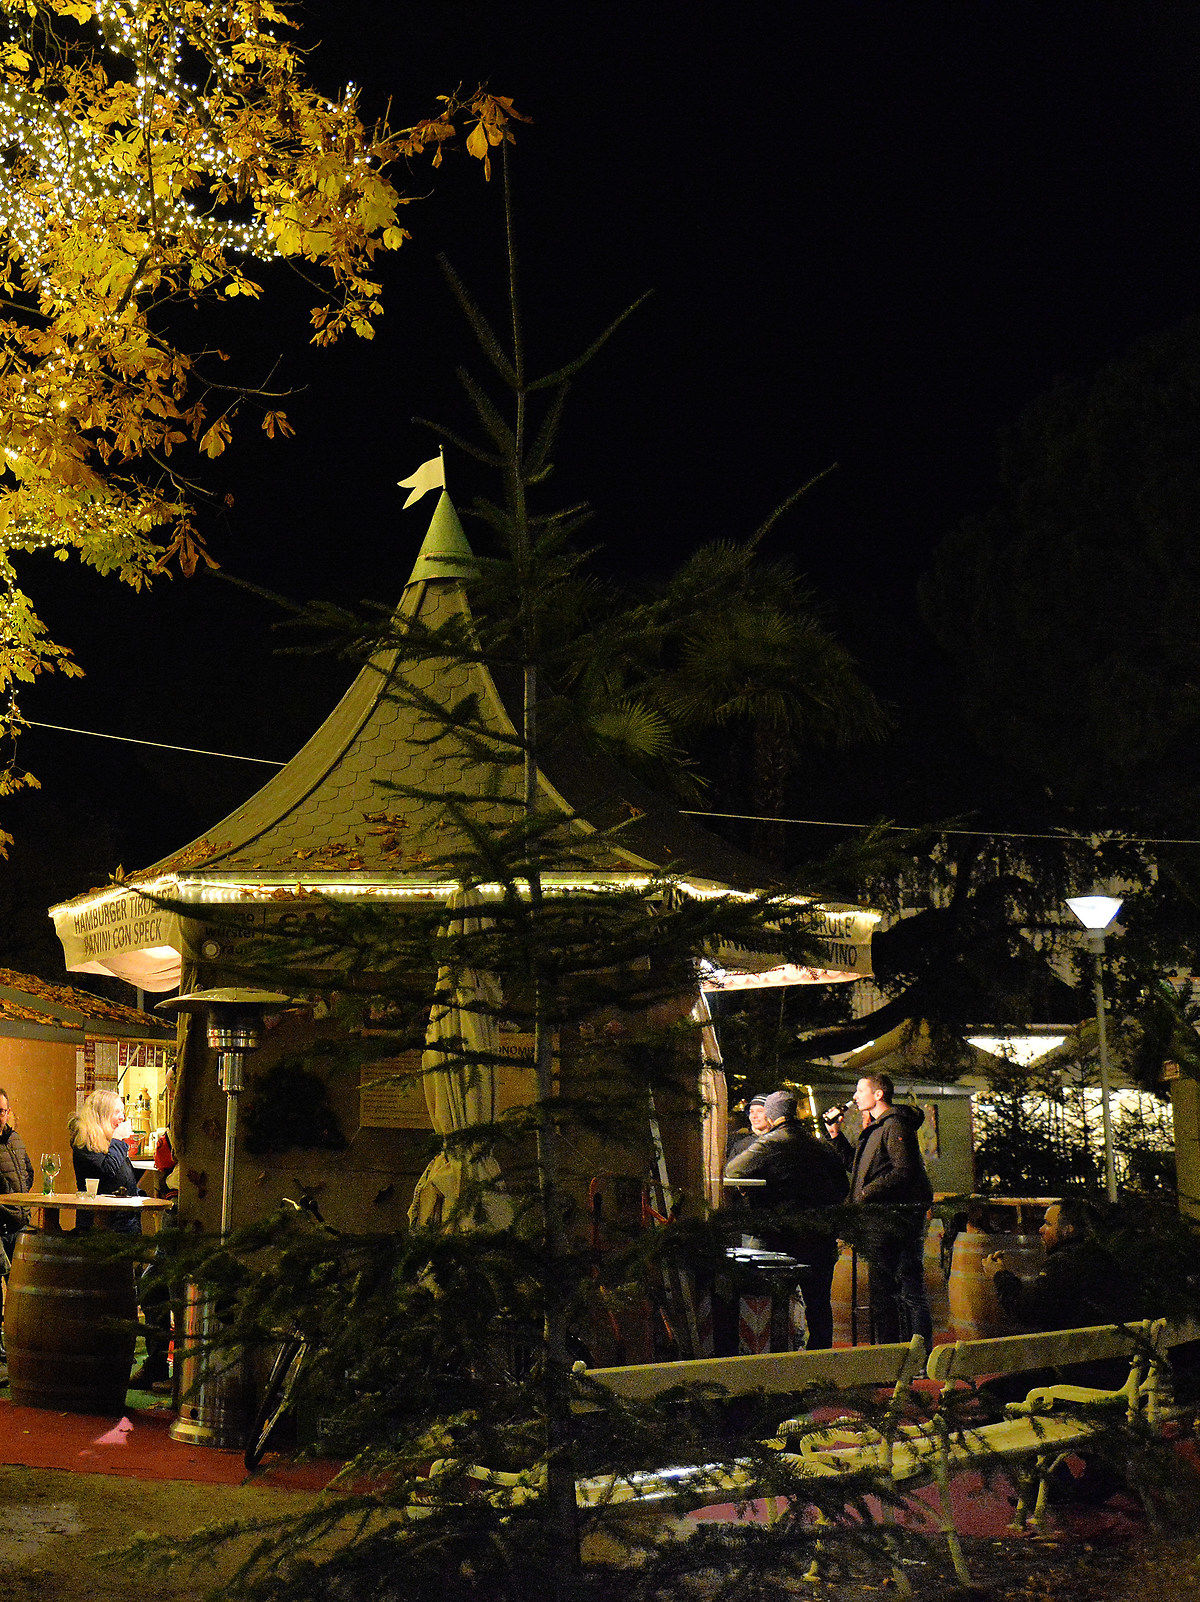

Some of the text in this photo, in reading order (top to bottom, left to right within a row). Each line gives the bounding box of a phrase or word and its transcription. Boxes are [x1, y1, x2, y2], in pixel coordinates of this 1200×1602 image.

[73, 898, 127, 935] HAMBURGER
[83, 918, 162, 957] PANINI CON SPECK
[826, 941, 858, 967] VINO
